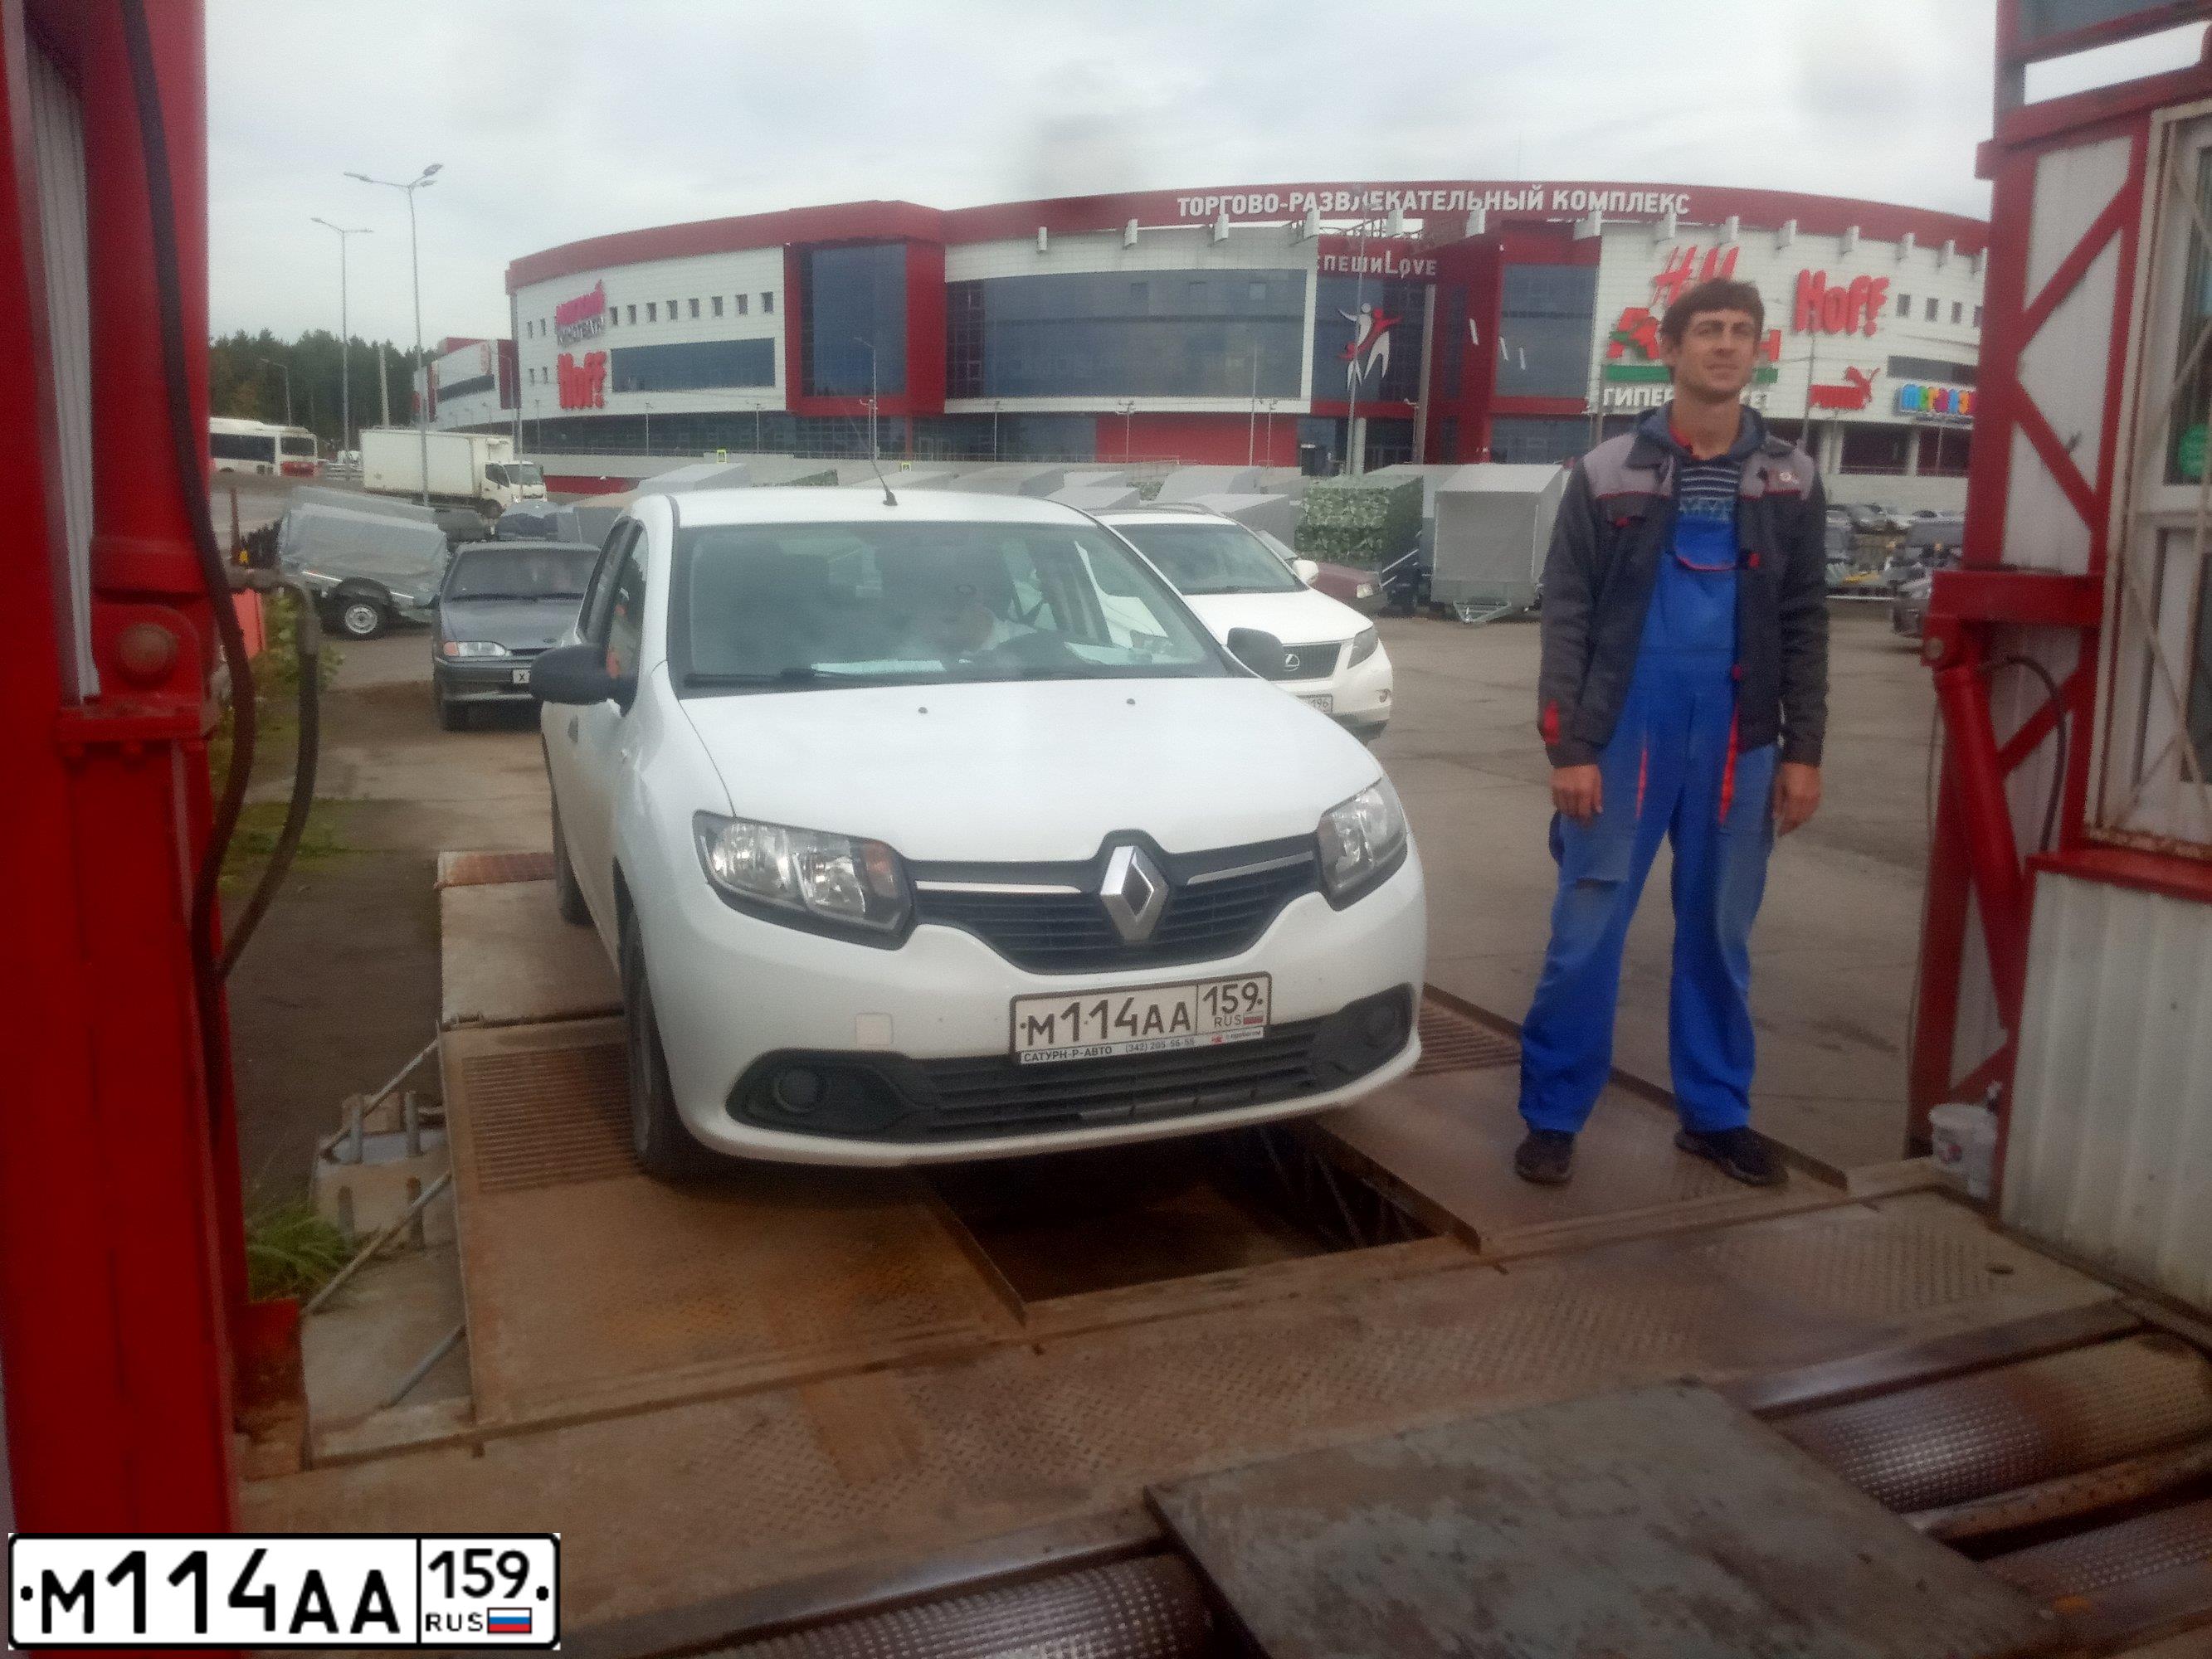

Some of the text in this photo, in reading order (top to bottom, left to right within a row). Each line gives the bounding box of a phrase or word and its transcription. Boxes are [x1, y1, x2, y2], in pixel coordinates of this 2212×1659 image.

[1551, 188, 1690, 216] КОМПЛЕКС
[1202, 981, 1259, 1017] 159
[1026, 995, 1191, 1046] М114АА
[1214, 1014, 1242, 1029] RUS
[1023, 1045, 1113, 1063] САТУРН-Р-АВТО
